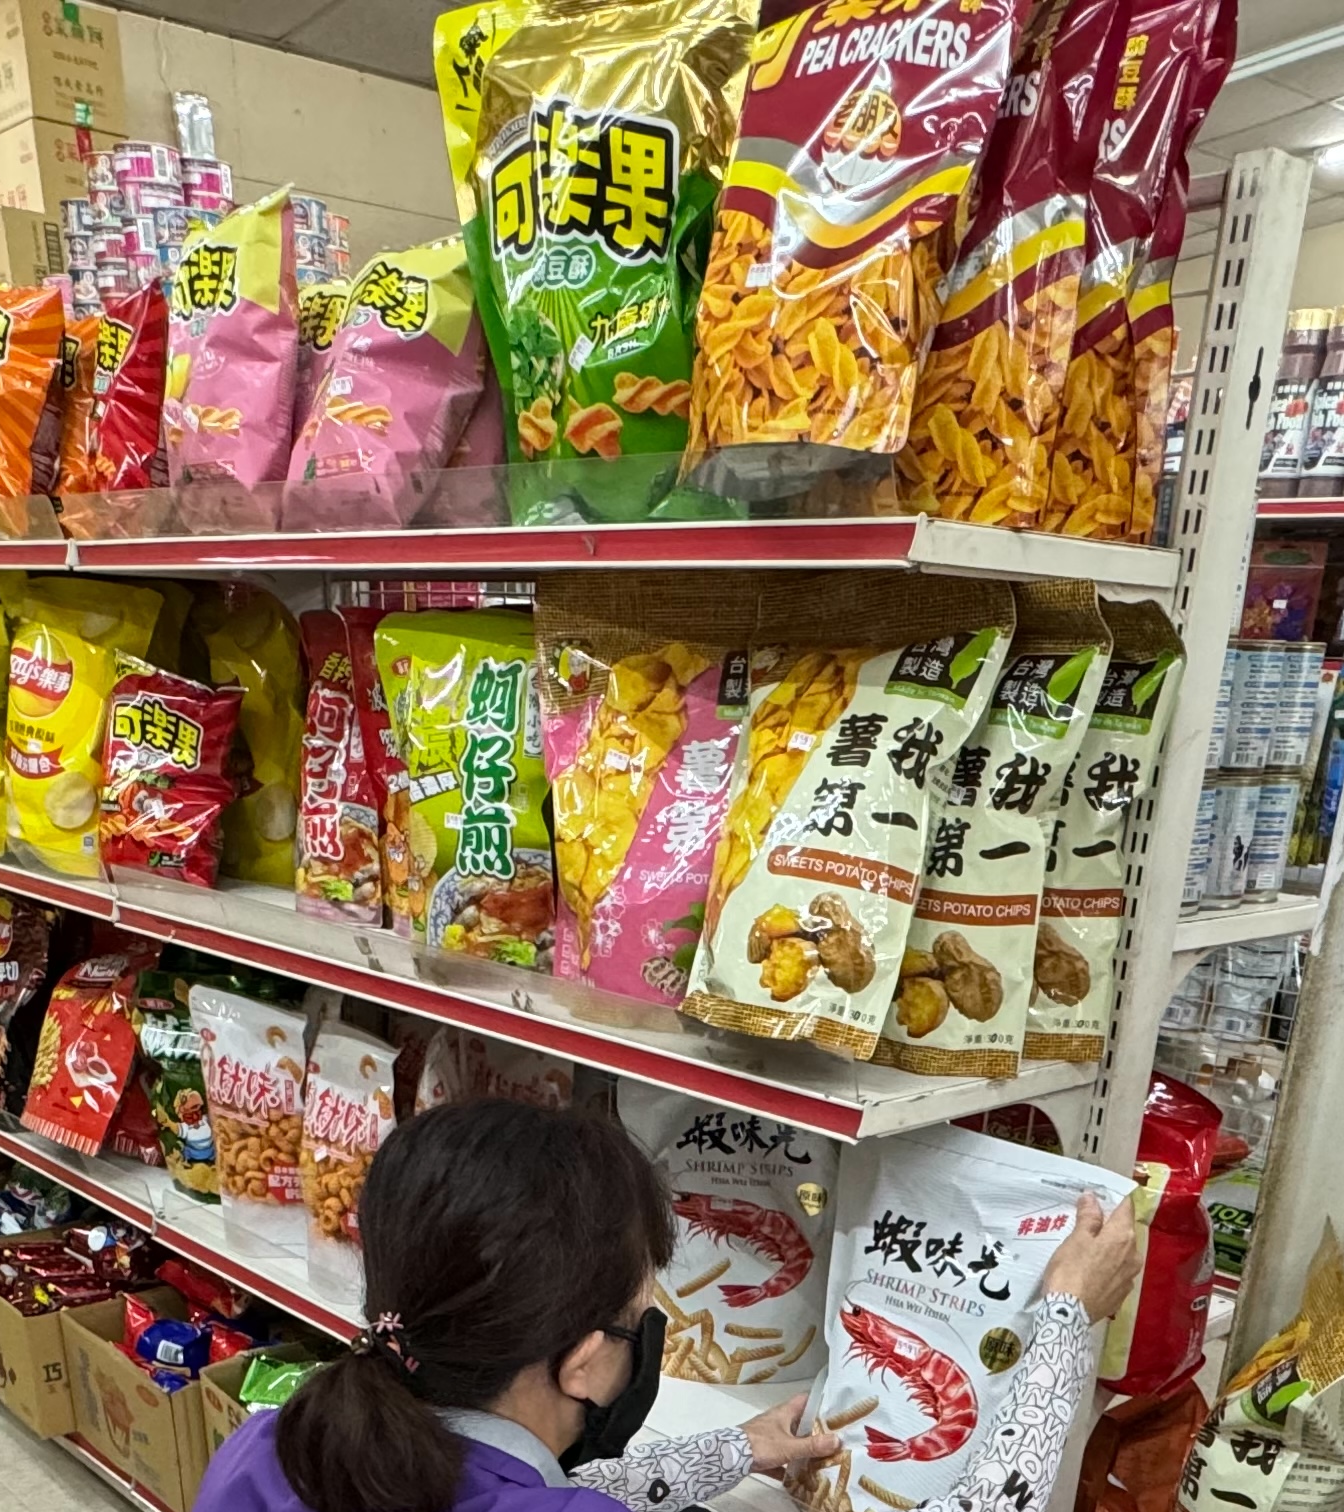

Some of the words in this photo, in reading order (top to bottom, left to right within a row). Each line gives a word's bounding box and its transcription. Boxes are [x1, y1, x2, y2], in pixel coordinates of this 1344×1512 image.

[795, 29, 836, 78] PEA
[841, 19, 970, 69] CRACKERS
[899, 657, 944, 681] 製造
[458, 660, 525, 877] 蚵仔煎
[774, 852, 824, 873] SWEETS
[826, 862, 878, 885] POTATO
[944, 902, 994, 918] POTATO
[996, 903, 1031, 918] CHIPS
[1042, 895, 1081, 910] OTATO
[1083, 897, 1120, 910] CHIPS
[686, 1158, 744, 1176] SHRIMP
[1017, 1213, 1069, 1237] 非油炸
[864, 1268, 927, 1298] SHRIMP
[929, 1286, 987, 1319] STRIPS
